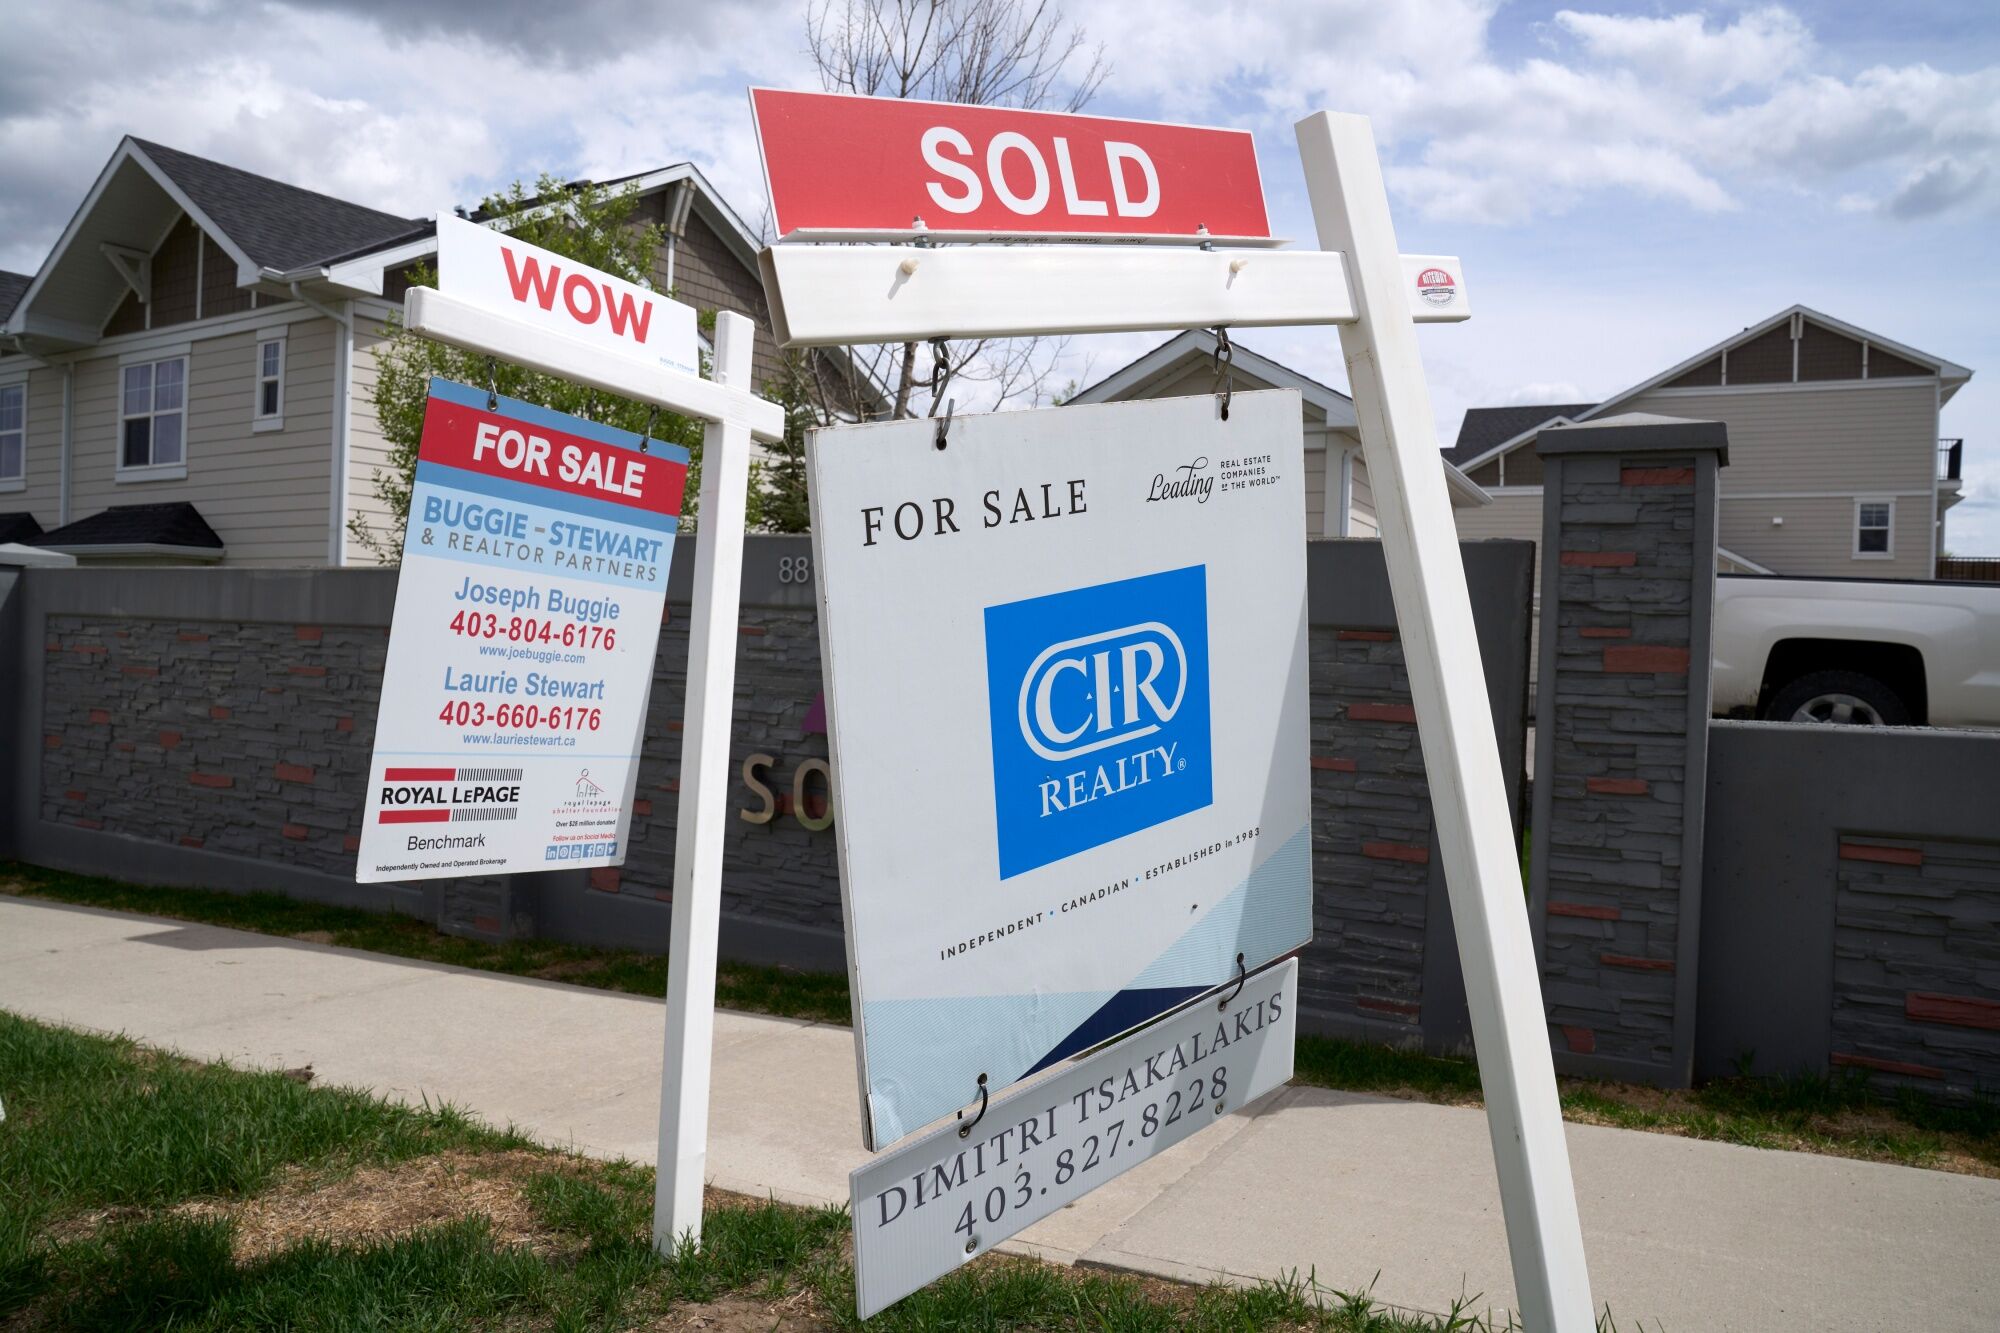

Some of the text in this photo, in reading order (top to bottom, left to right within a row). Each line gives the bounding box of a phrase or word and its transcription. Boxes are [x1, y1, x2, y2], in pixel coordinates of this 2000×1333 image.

[920, 126, 1160, 219] SOLD
[501, 246, 653, 344] WOW
[473, 422, 646, 498] FOR SALE
[1146, 456, 1214, 504] Leading
[1220, 455, 1271, 469] REAL ESTATE
[1221, 467, 1266, 480] COMPANIES
[1231, 481, 1246, 490] THE
[423, 495, 528, 539] BUGGIE
[549, 520, 663, 563] STEWART
[861, 479, 1088, 547] FOR SALE
[421, 527, 657, 582] & REALTOR PARTNERS
[455, 576, 620, 623] Joseph Buggie
[450, 610, 616, 650] 403-804-6176
[479, 645, 586, 664] www.joebuggie.com
[444, 666, 605, 700] Laurie Stewart
[439, 700, 601, 730] 403-660-6176
[463, 733, 576, 746] www.lauriestewart.ca
[381, 787, 447, 804] ROYAL
[407, 833, 485, 850] Benchmark
[376, 863, 418, 872] Independently
[420, 861, 440, 869] Owned
[453, 859, 479, 867] Operated
[941, 827, 1260, 961] INDEPENDENT CANADIAN ESTABLISHED in 1983
[877, 992, 1283, 1228] DIMITRI TSAKALAKIS
[954, 1067, 1228, 1237] 403.827.8228
